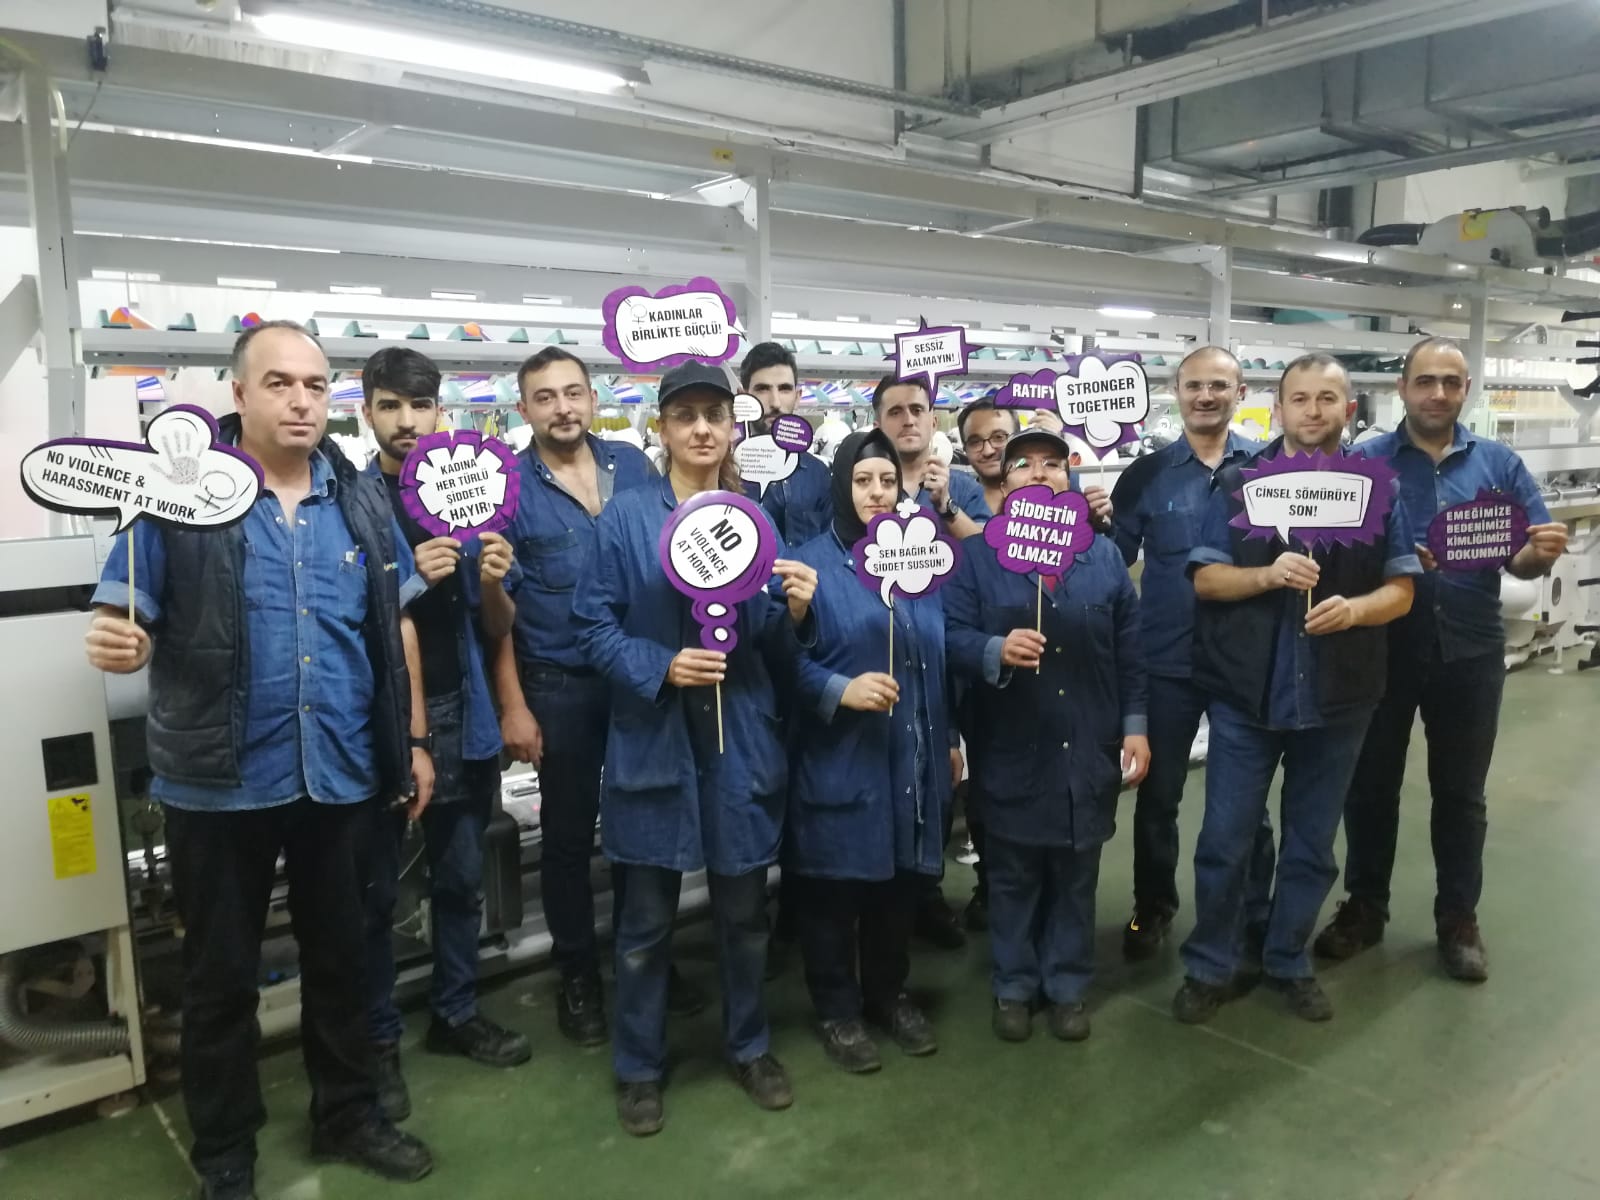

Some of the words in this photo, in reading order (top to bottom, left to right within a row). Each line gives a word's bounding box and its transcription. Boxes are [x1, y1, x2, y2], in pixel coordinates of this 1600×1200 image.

[649, 308, 703, 322] KADINLAR
[632, 325, 682, 341] BİRLİKTE
[684, 320, 722, 339] GÜÇLÜ!
[914, 339, 944, 353] SESSİZ
[906, 353, 955, 368] KALMAYIN!
[1012, 383, 1055, 400] RATIFY
[1067, 377, 1135, 396] STRONGER
[1069, 396, 1136, 414] TOGETHER
[46, 450, 64, 465] NO
[69, 455, 131, 485] VIOLENCE
[135, 474, 145, 488] &
[440, 458, 477, 475] KADINA
[436, 478, 456, 492] HER
[457, 468, 489, 486] TÜRLÜ
[42, 468, 131, 504] HARASSMENT
[134, 495, 152, 509] AT
[157, 499, 197, 520] WORK
[1255, 485, 1291, 499] CİNSEL
[1294, 486, 1356, 502] SÖMÜRÜYE
[449, 501, 492, 521] HAYIR!
[1010, 497, 1077, 526] ŞİDDETİN
[1288, 504, 1318, 517] SON!
[1446, 505, 1512, 521] EMEĞİMİZE
[709, 518, 742, 551] NO
[1006, 520, 1073, 547] MAKYAJI
[1446, 518, 1512, 534] BEDENİMİZE
[1446, 531, 1512, 547] KİMLİĞİMİZE
[690, 527, 729, 575] VIOLENCE
[879, 549, 896, 559] SEN
[899, 545, 926, 557] BAĞIR
[929, 543, 938, 554] Kİ
[1007, 543, 1063, 567] OLMAZ!
[1446, 545, 1511, 561] DOKUNMA!
[676, 540, 692, 553] AT
[687, 552, 714, 584] HOME
[873, 561, 904, 573] ŞİDDET
[907, 558, 945, 570] SUSSUN!
